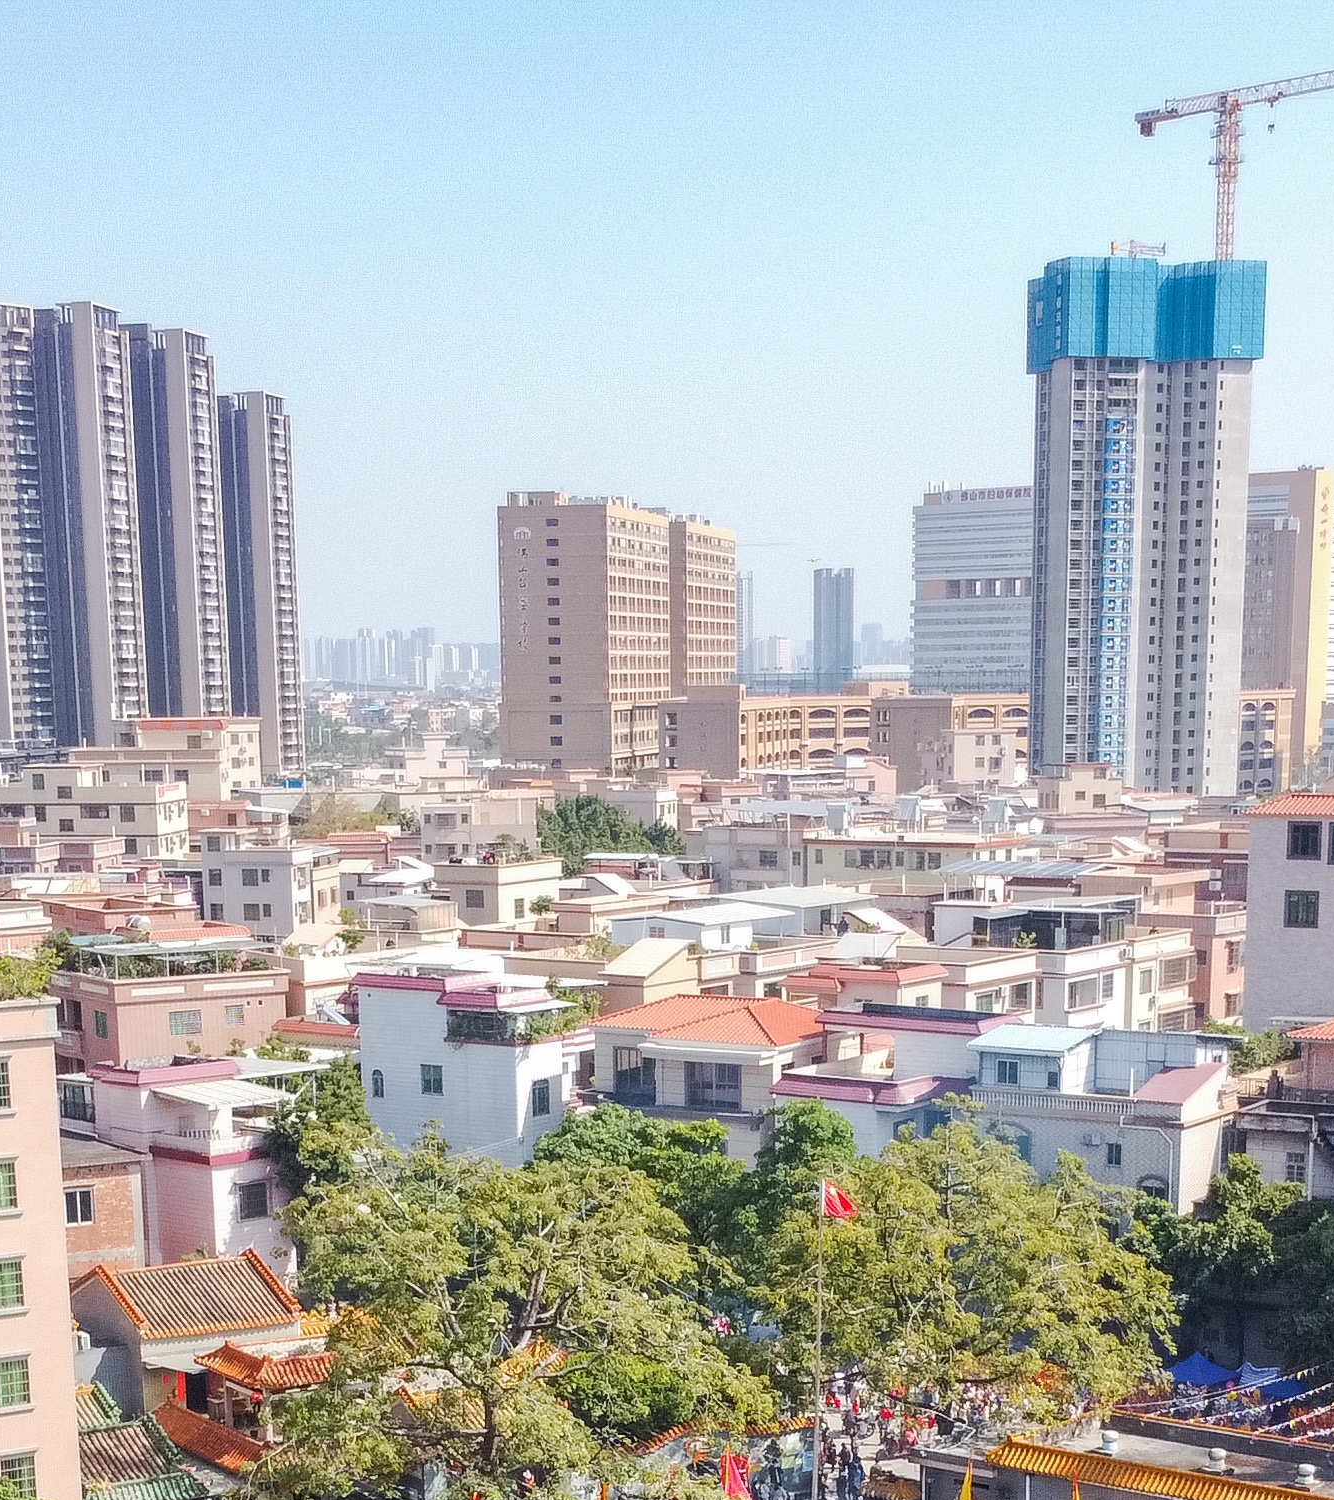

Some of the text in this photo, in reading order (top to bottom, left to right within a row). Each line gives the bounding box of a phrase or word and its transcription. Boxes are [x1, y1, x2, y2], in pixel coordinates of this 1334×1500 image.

[960, 487, 1032, 501] 佛山市妇幼保健院
